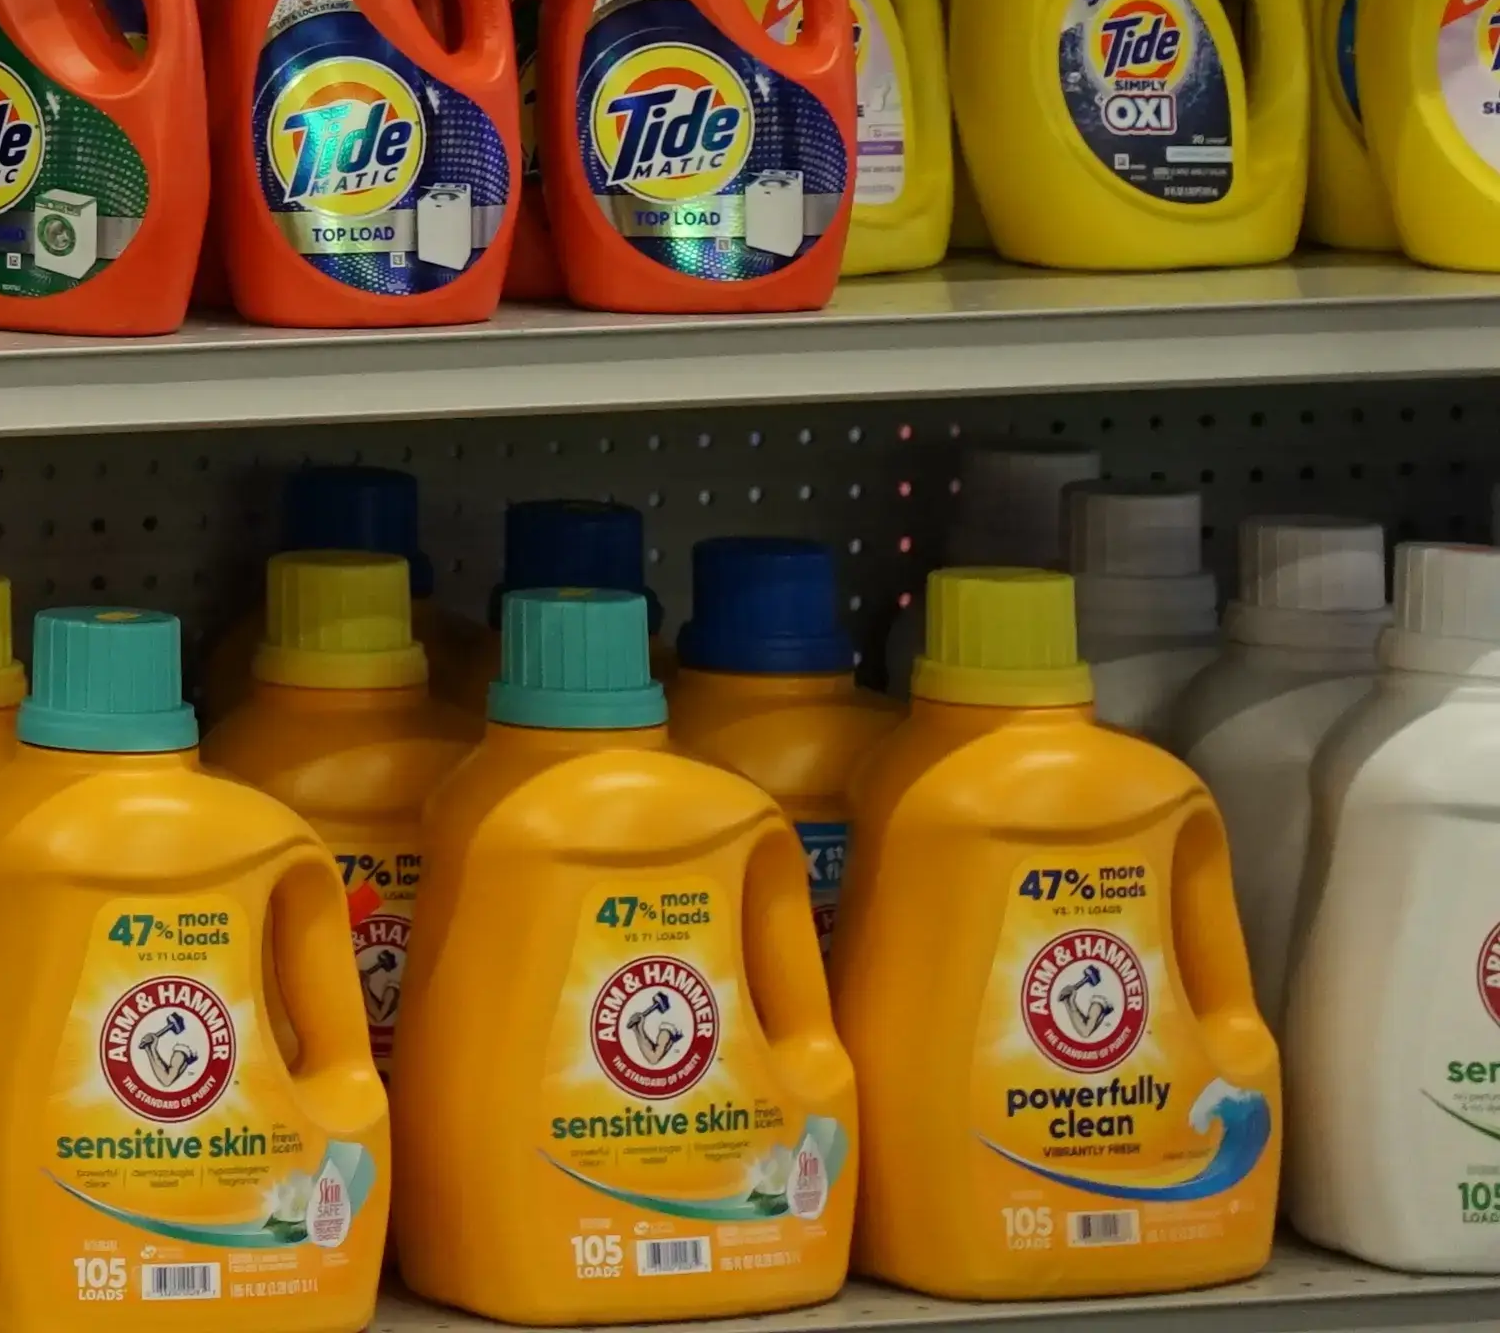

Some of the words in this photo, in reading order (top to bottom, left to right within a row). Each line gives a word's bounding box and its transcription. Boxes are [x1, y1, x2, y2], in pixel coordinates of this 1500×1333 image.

[1103, 16, 1180, 78] Tide
[1114, 80, 1168, 92] SIMPLY
[1108, 96, 1172, 130] OXI
[607, 89, 741, 182] Tide
[284, 102, 412, 200] Tide
[635, 211, 670, 226] TOP
[674, 211, 721, 225] LOAD
[312, 227, 347, 242] TOP
[350, 226, 395, 241] LOAD
[1100, 866, 1145, 881] more
[660, 892, 710, 906] more
[1100, 882, 1147, 899] loads
[177, 913, 229, 927] more
[660, 908, 711, 926] loads
[177, 929, 230, 946] loads
[108, 1008, 137, 1063] ARM
[158, 984, 231, 1062] HAMMER
[598, 987, 628, 1043] ARM
[1007, 1076, 1171, 1118] powerfully
[551, 1106, 688, 1140] sensitive
[694, 1102, 750, 1134] skin
[1049, 1111, 1134, 1140] clean
[56, 1128, 203, 1160] sensitive
[208, 1125, 267, 1157] skin
[1108, 1144, 1140, 1155] FRESH
[571, 1233, 624, 1266] 105
[74, 1257, 128, 1288] 105
